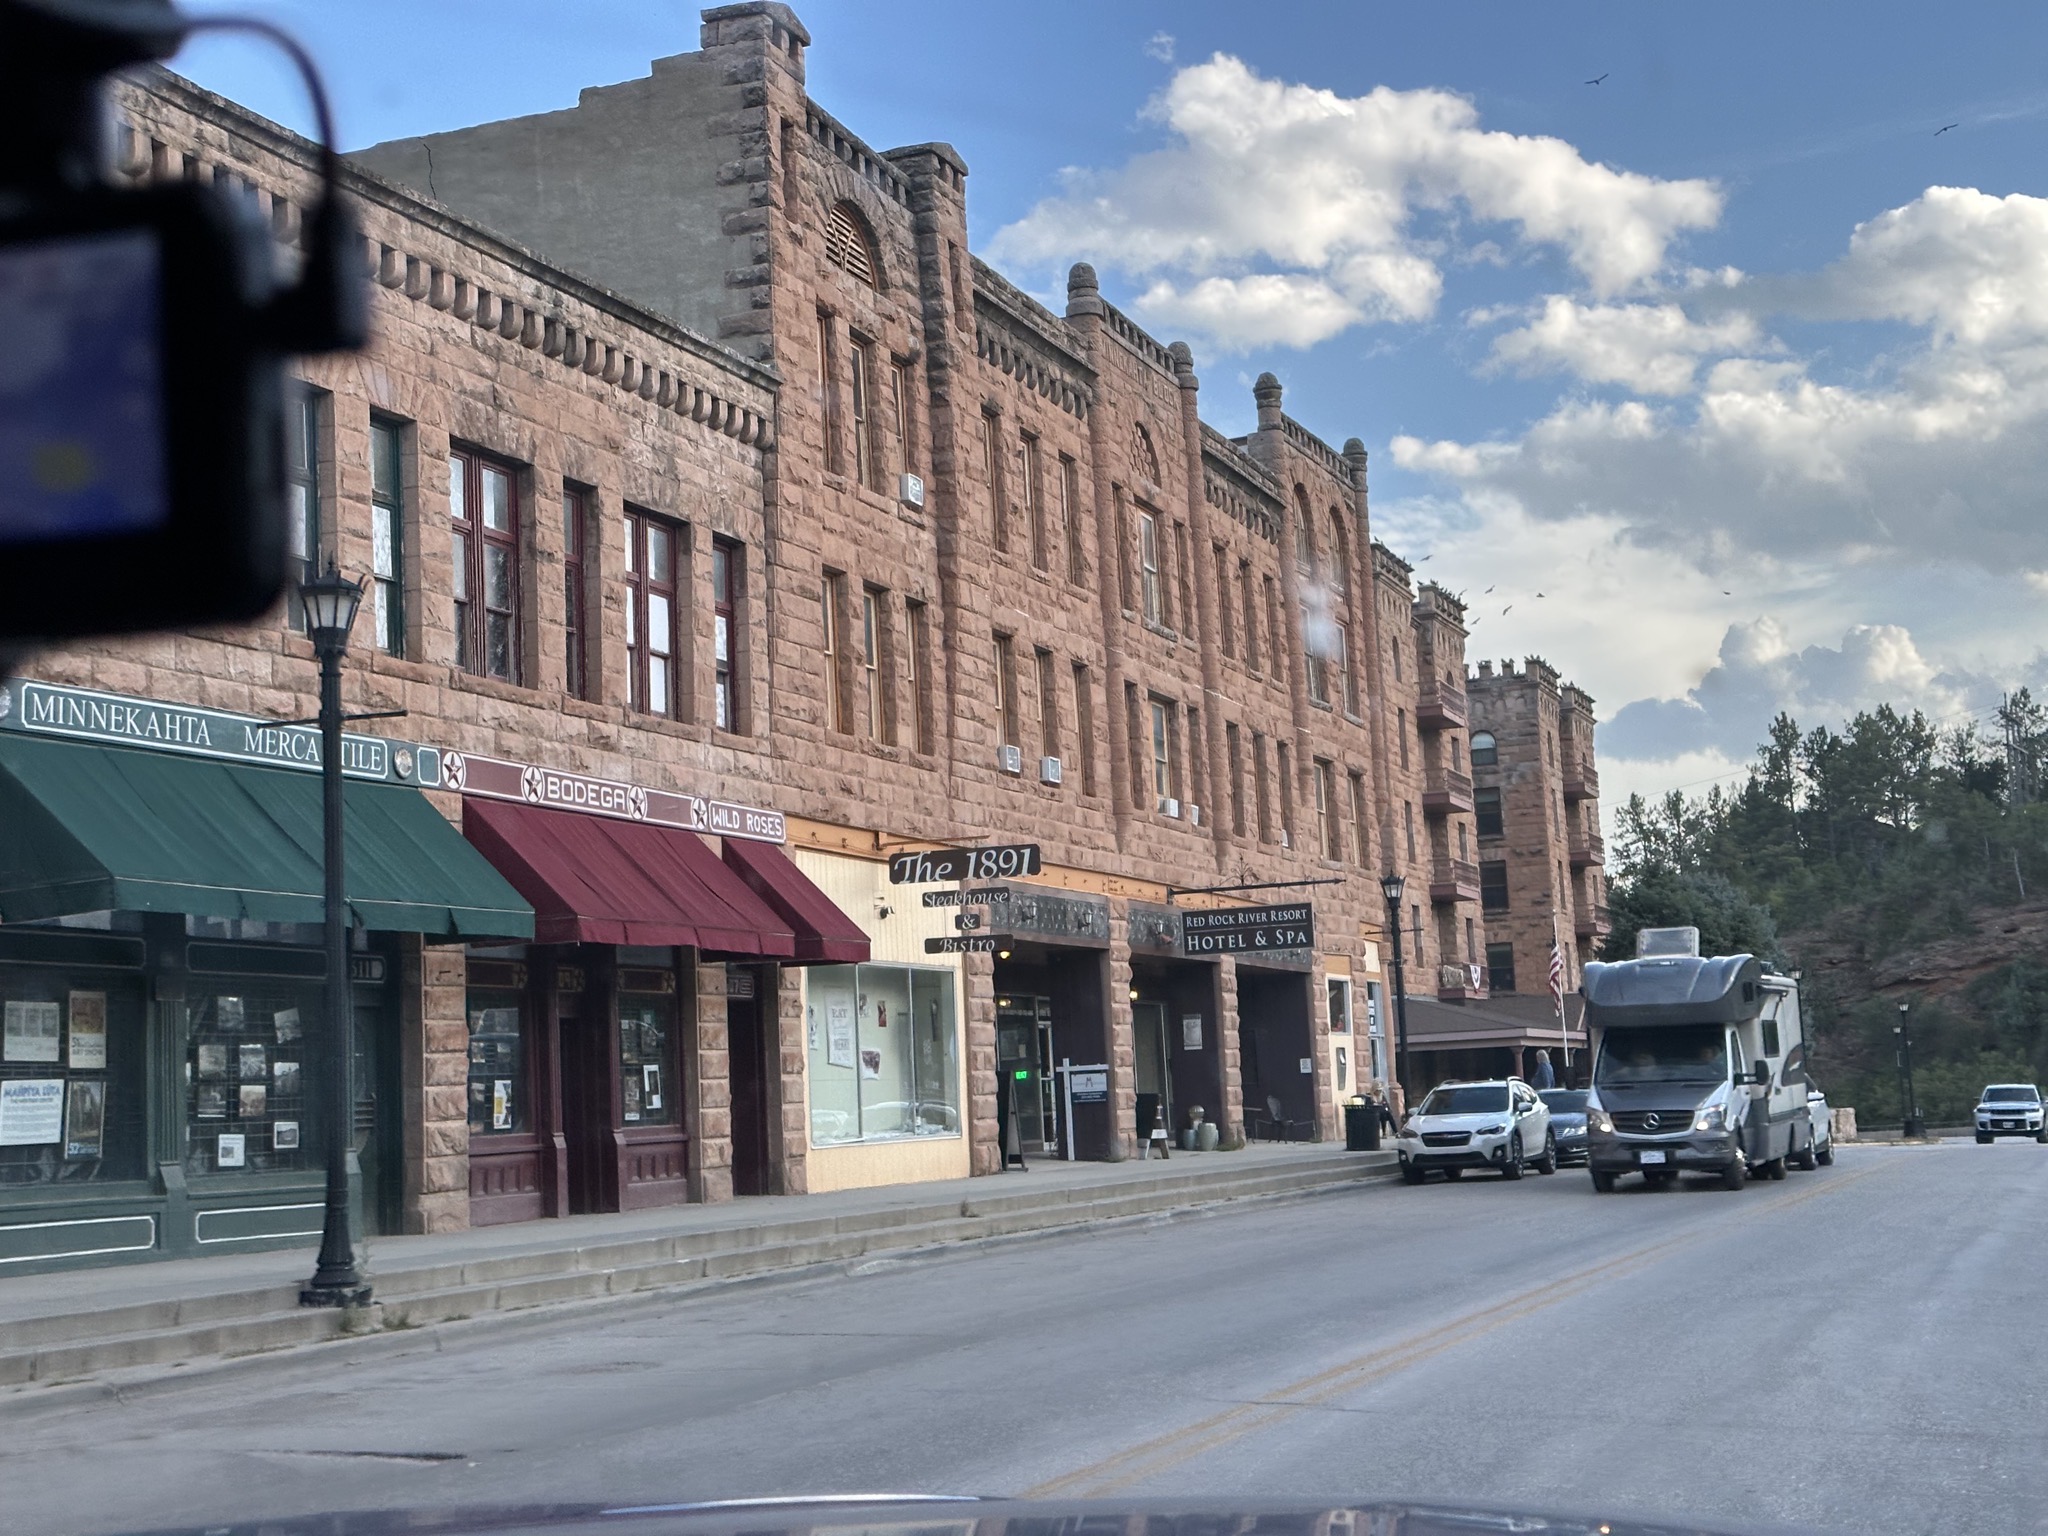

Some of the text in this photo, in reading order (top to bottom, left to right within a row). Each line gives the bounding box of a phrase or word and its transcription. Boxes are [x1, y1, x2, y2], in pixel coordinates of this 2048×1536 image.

[31, 692, 384, 771] MINNEKAHTA MERCATILE
[547, 776, 626, 810] BODEGA
[712, 807, 783, 836] WILD ROSES
[894, 848, 1033, 884] The 1891
[924, 889, 1009, 908] Steakhouse
[961, 914, 976, 930] &
[1186, 908, 1308, 928] RED ROCK RIVER RESORT
[939, 937, 996, 954] Bistro
[1187, 929, 1308, 951] HOTEL & SPA
